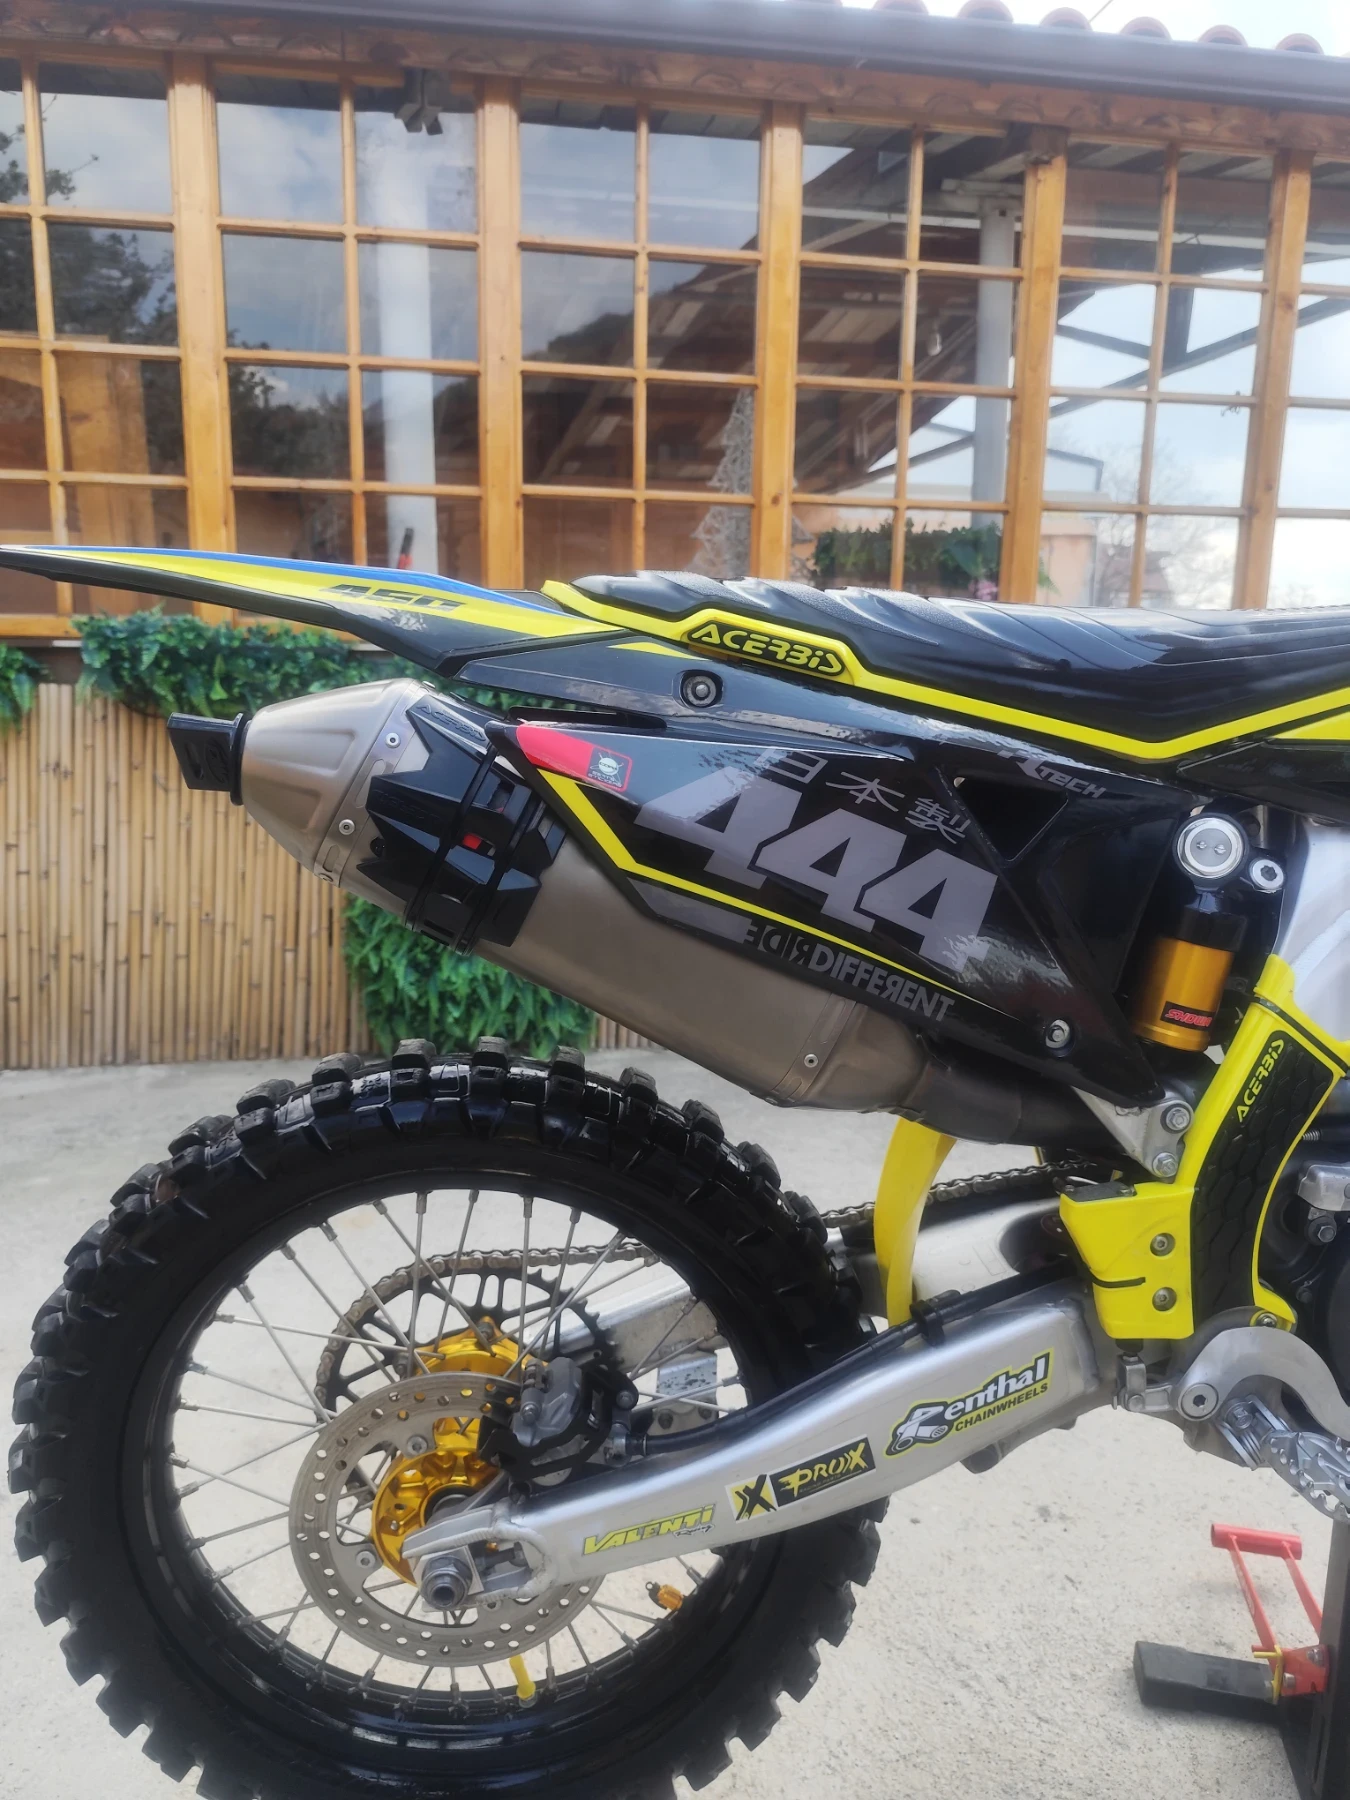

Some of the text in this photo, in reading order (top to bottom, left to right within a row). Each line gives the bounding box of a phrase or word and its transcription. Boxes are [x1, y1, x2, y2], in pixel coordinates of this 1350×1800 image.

[691, 623, 843, 674] ACERBIS
[753, 747, 972, 845] 日本製
[634, 766, 998, 974] 444
[1236, 1038, 1285, 1123] ACERBIS
[954, 1382, 1049, 1432] CHAINWHEELS
[583, 1505, 716, 1556] VALENTI
